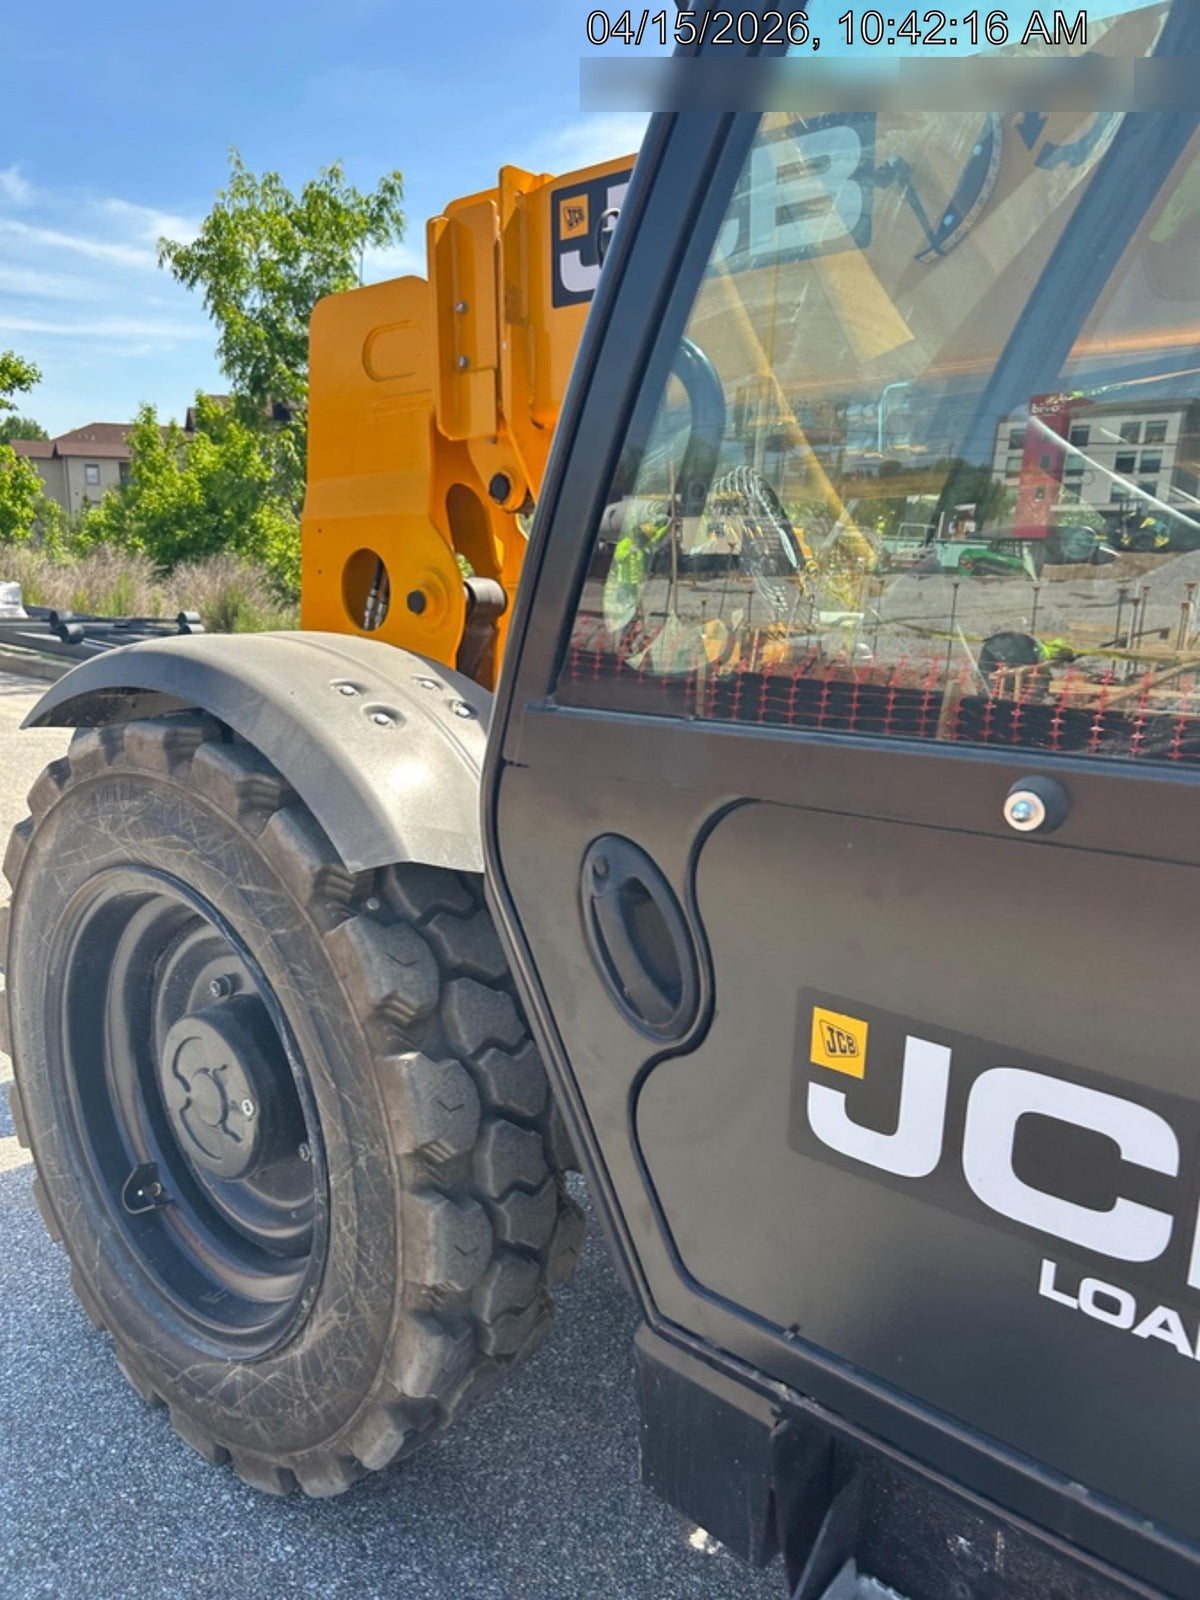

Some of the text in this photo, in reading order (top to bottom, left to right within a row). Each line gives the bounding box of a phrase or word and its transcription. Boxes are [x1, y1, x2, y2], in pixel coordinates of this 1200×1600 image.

[826, 1026, 857, 1056] JCB
[807, 1036, 1200, 1289] JC
[1039, 1259, 1200, 1361] LOA
